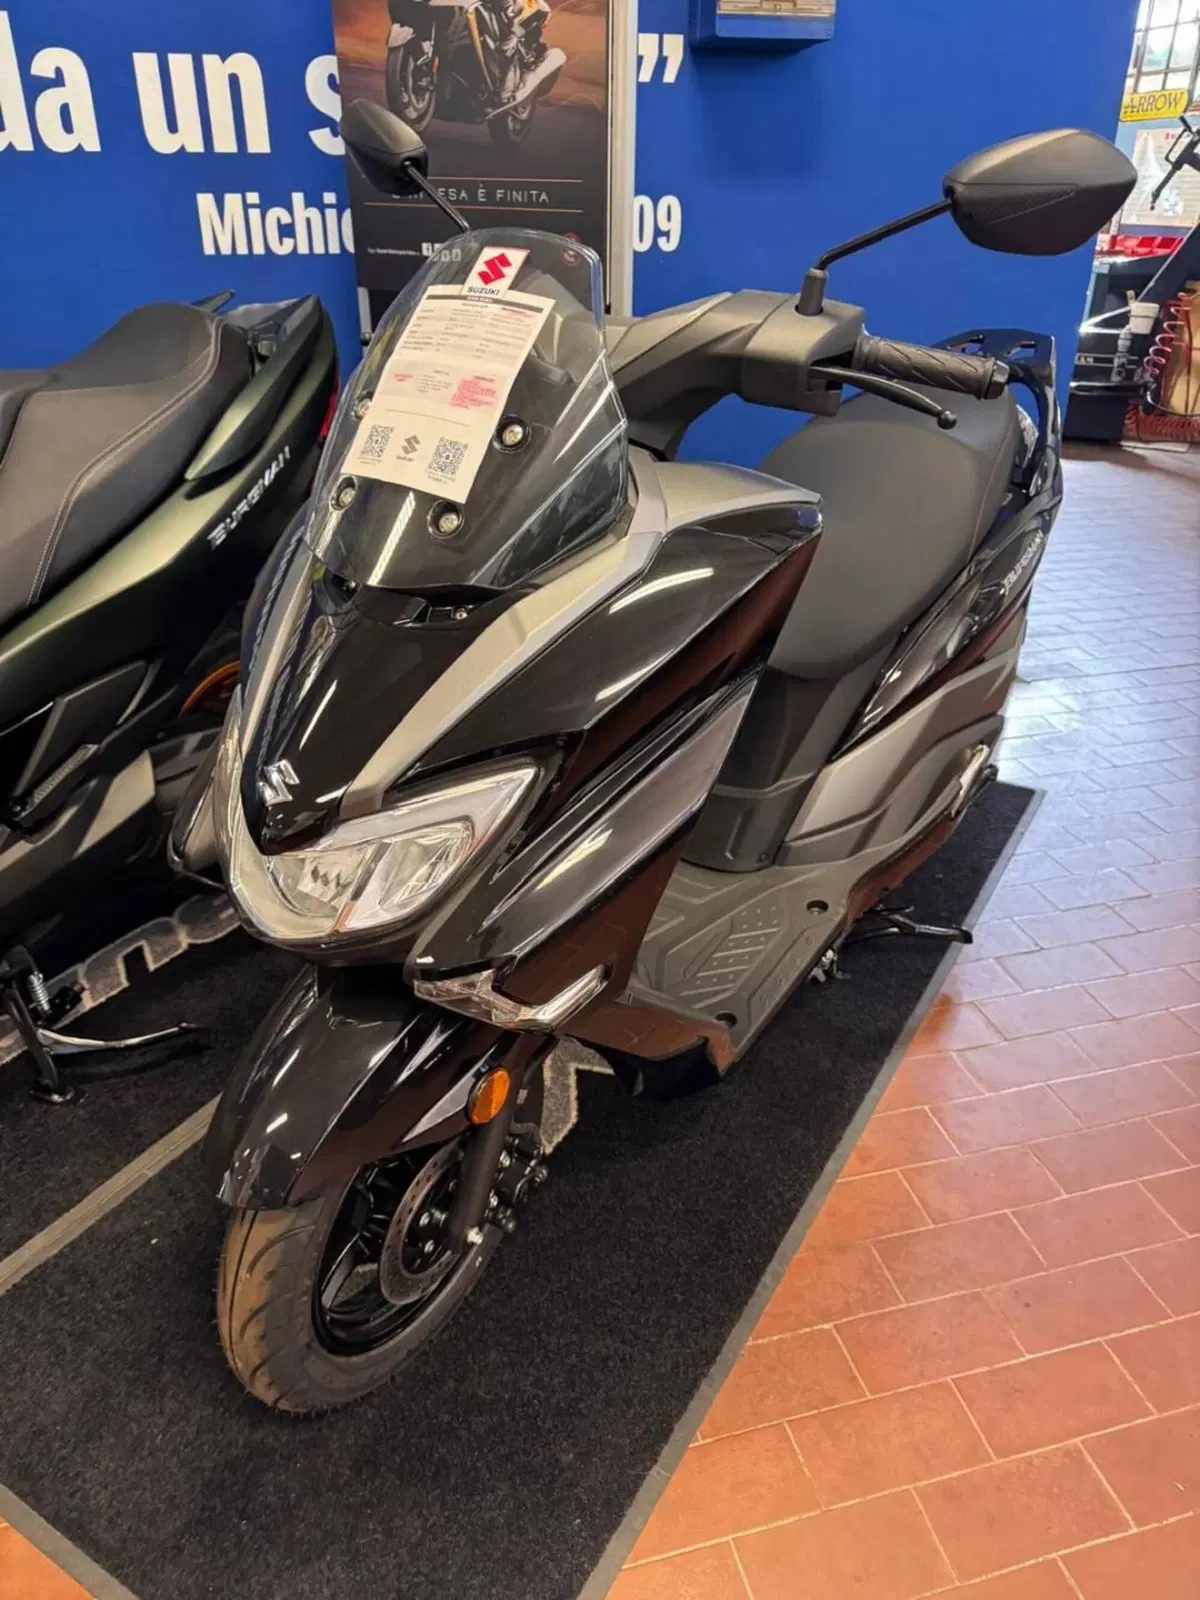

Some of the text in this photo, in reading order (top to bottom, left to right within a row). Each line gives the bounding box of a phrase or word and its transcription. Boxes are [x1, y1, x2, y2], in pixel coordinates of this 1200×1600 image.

[132, 52, 271, 154] un
[1123, 92, 1184, 114] ARROW
[496, 189, 549, 203] FINITA
[466, 286, 500, 296] SUZUKI
